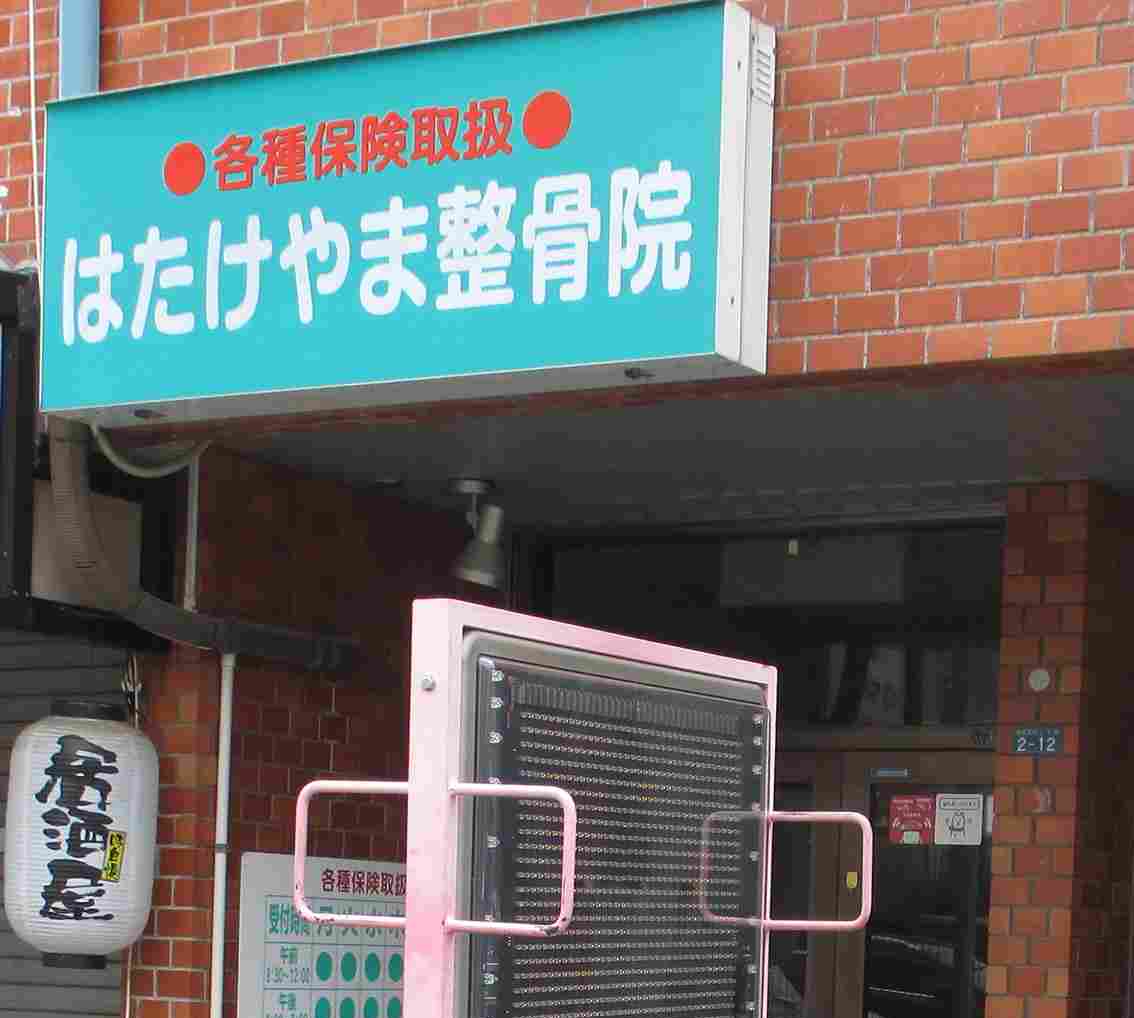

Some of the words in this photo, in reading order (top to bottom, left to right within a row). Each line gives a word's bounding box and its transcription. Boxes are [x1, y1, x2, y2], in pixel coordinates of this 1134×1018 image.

[212, 97, 514, 193] 各種保険取扱
[62, 159, 693, 345] はたけやま整骨院
[1017, 737, 1056, 752] 2-12
[34, 734, 120, 922] 居酒屋
